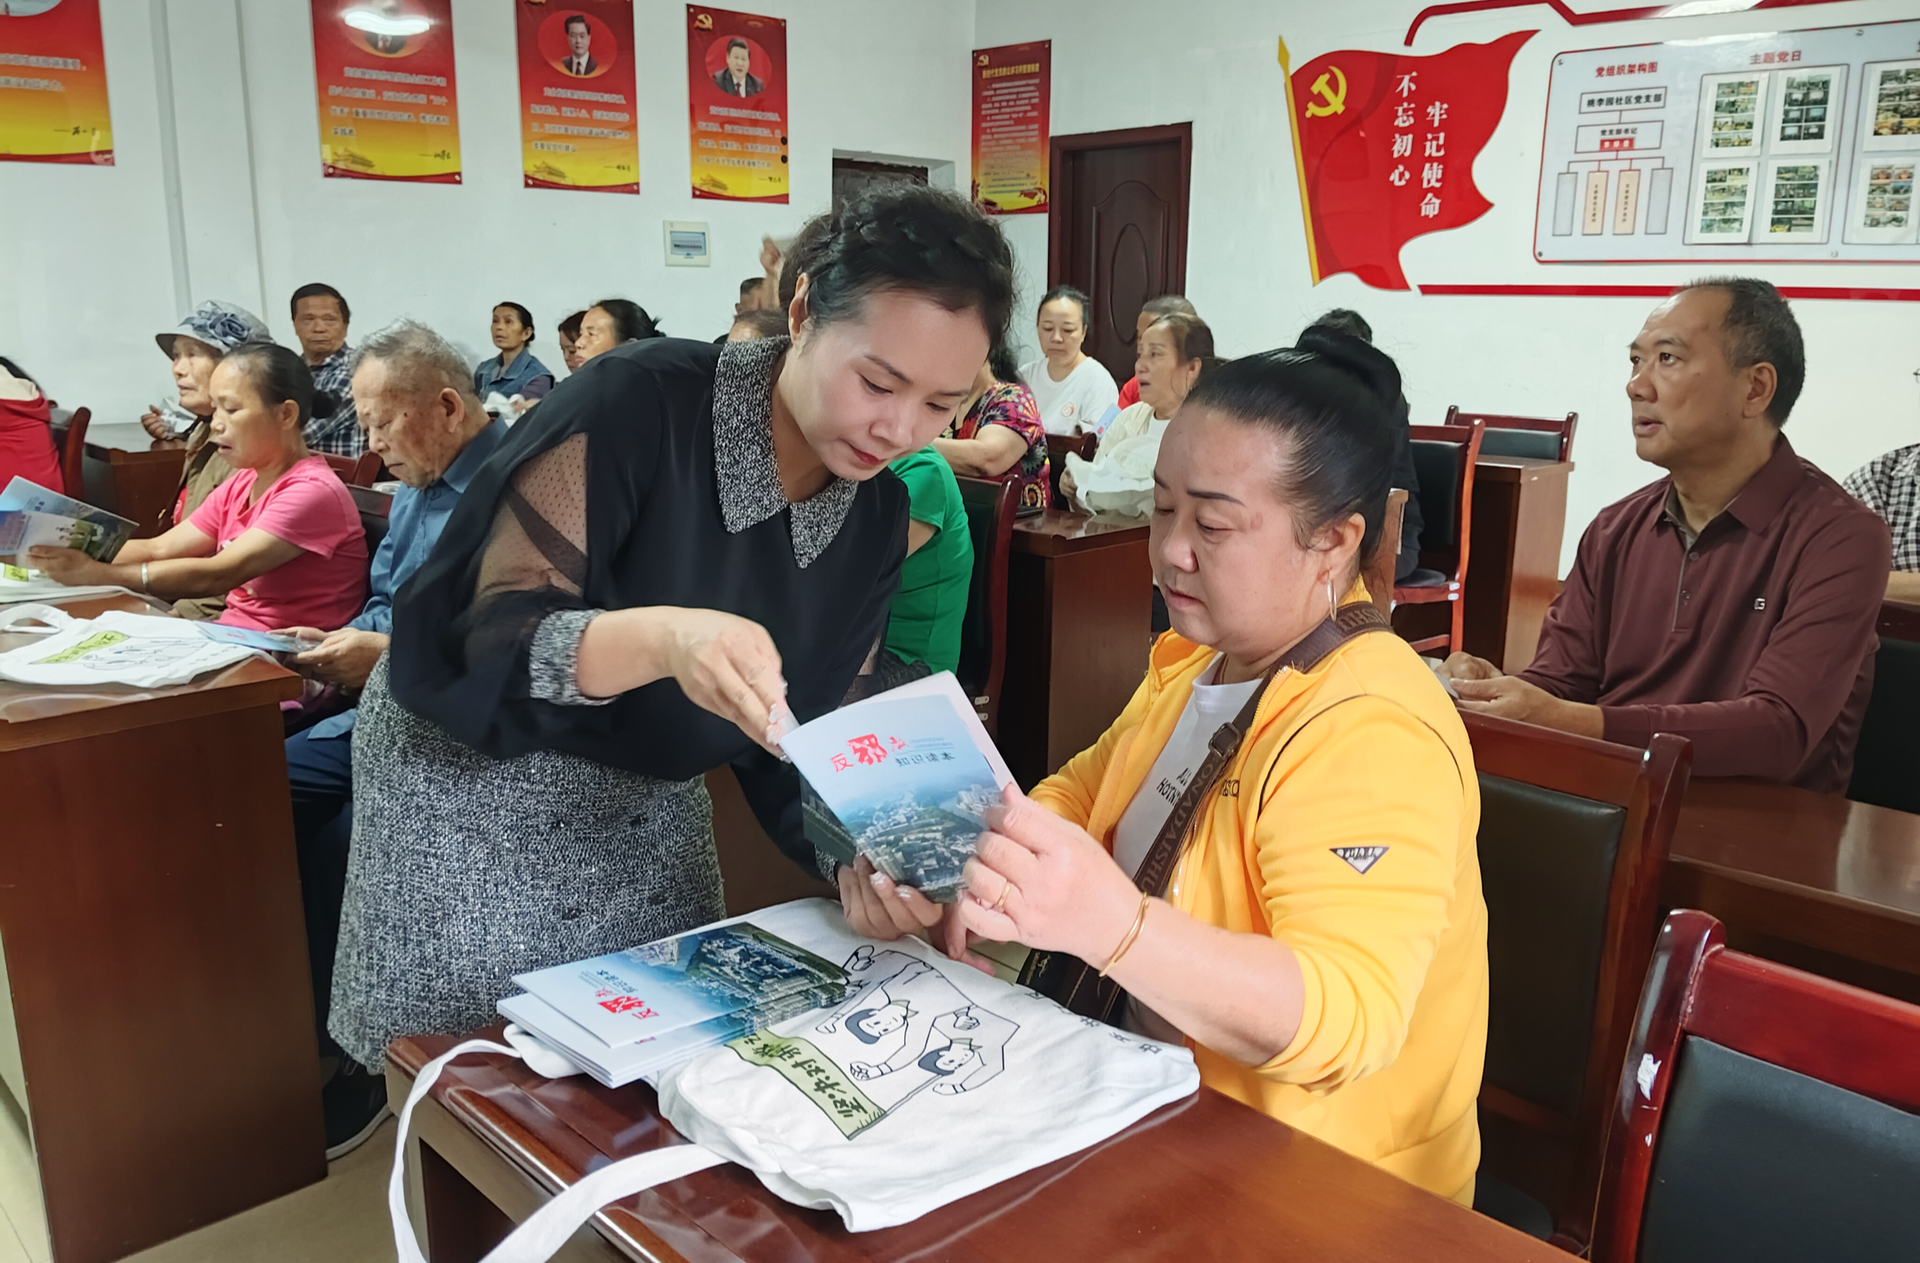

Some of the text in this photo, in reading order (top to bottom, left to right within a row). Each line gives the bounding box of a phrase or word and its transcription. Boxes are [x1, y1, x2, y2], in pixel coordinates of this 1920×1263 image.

[1750, 50, 1802, 65] 主题党日
[1595, 61, 1658, 78] 党组织架构图
[1587, 93, 1662, 107] 桃李园社区党支部
[1389, 72, 1417, 187] 不忘初心
[1600, 127, 1637, 136] 党支部书记
[1420, 101, 1449, 218] 牢记使命
[894, 751, 956, 767] 知识读本
